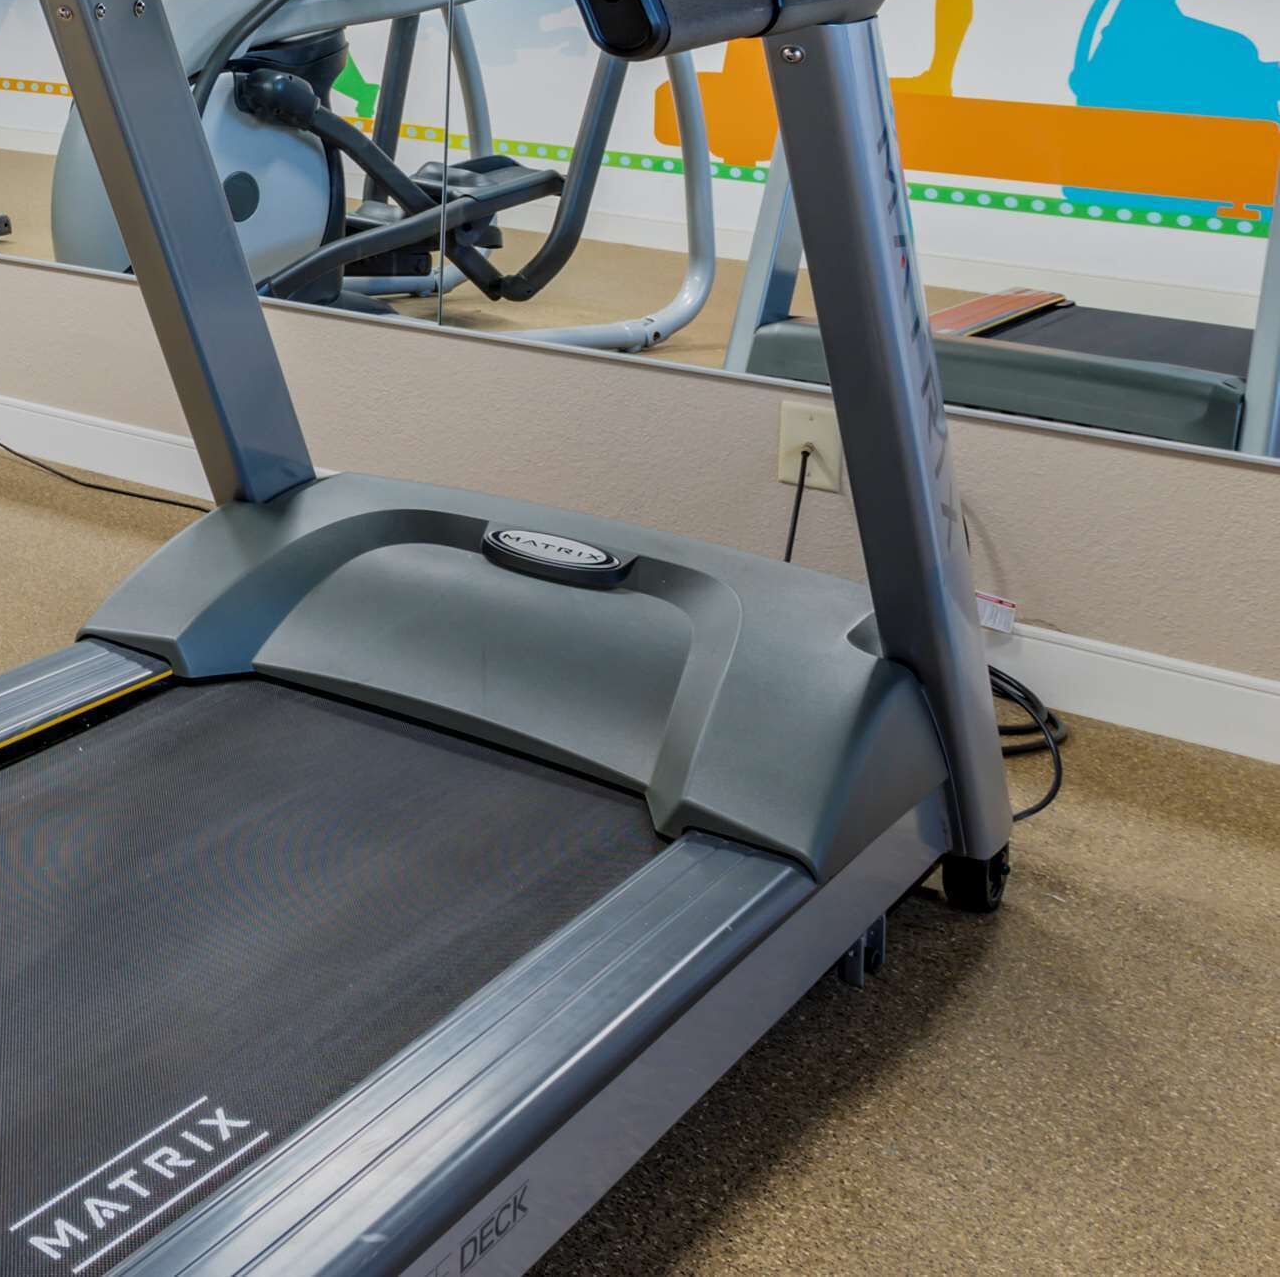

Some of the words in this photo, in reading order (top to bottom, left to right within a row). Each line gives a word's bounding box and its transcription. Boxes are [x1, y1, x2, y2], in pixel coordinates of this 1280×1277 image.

[503, 533, 601, 561] MATRIX
[29, 1107, 250, 1260] MATRIX
[460, 1184, 529, 1273] DECK
